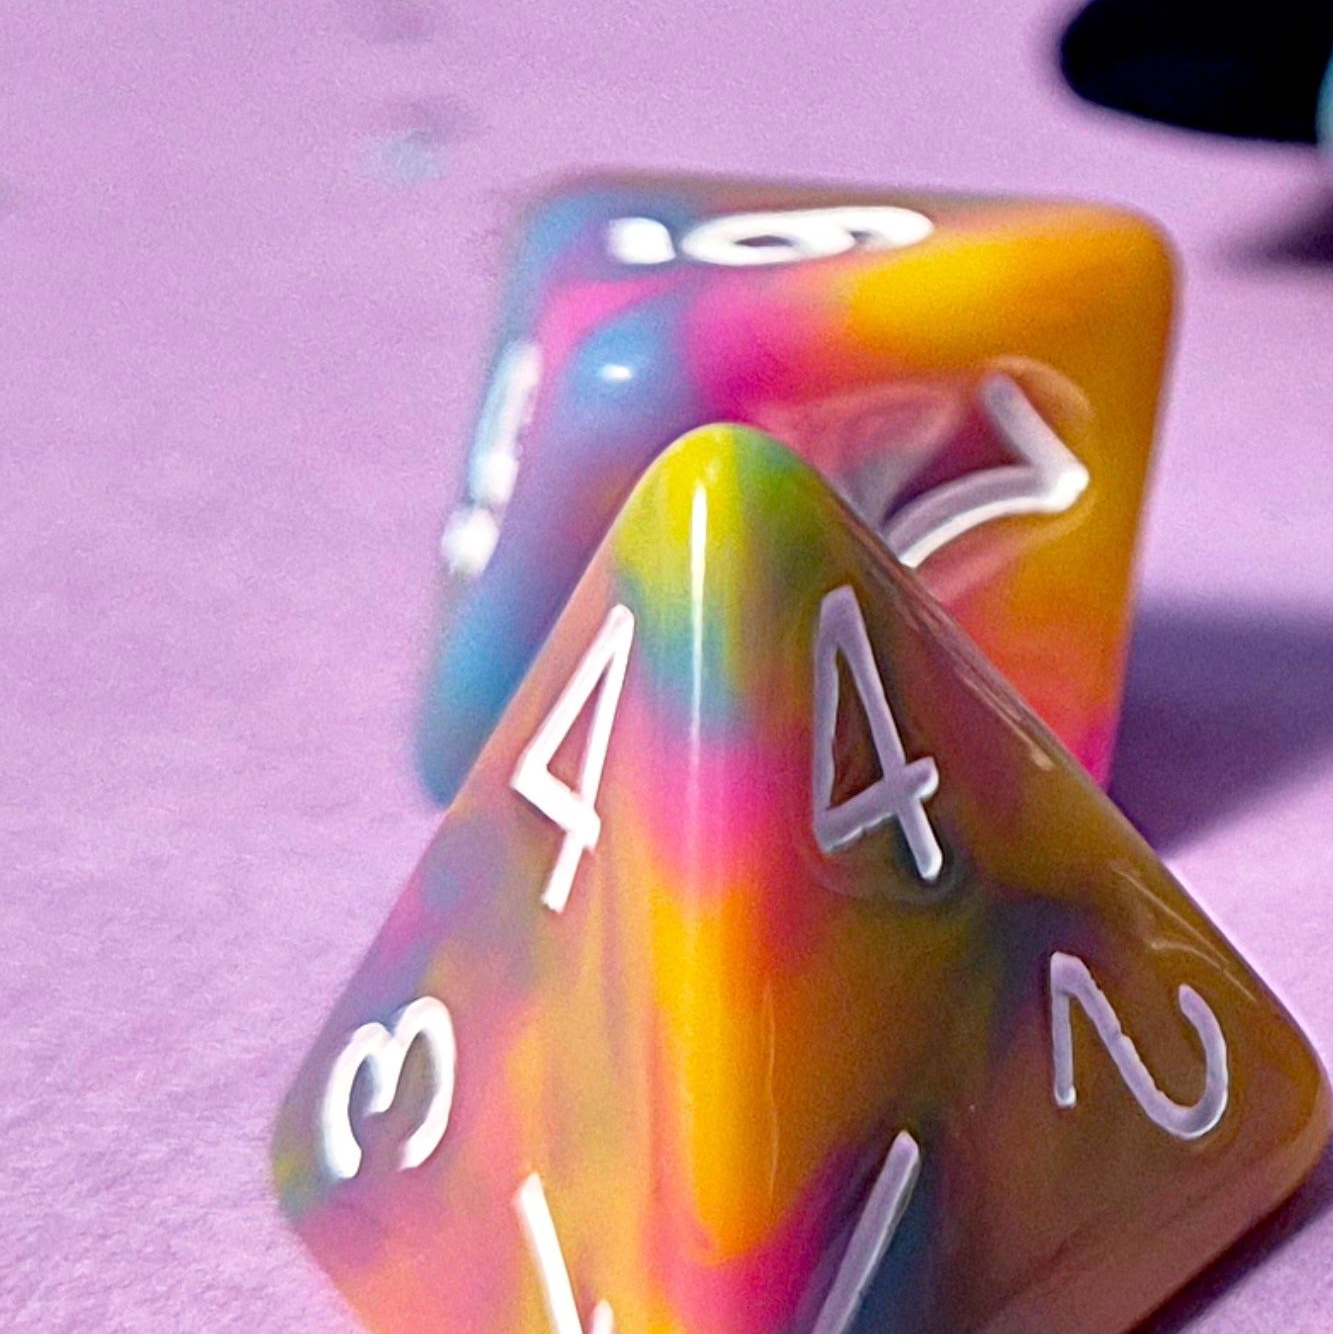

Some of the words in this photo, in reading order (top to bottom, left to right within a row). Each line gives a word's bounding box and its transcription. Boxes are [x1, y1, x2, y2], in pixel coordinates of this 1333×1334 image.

[510, 603, 636, 913] 4
[813, 585, 943, 881] 4
[322, 995, 457, 1180] 3
[1050, 952, 1230, 1142] 2
